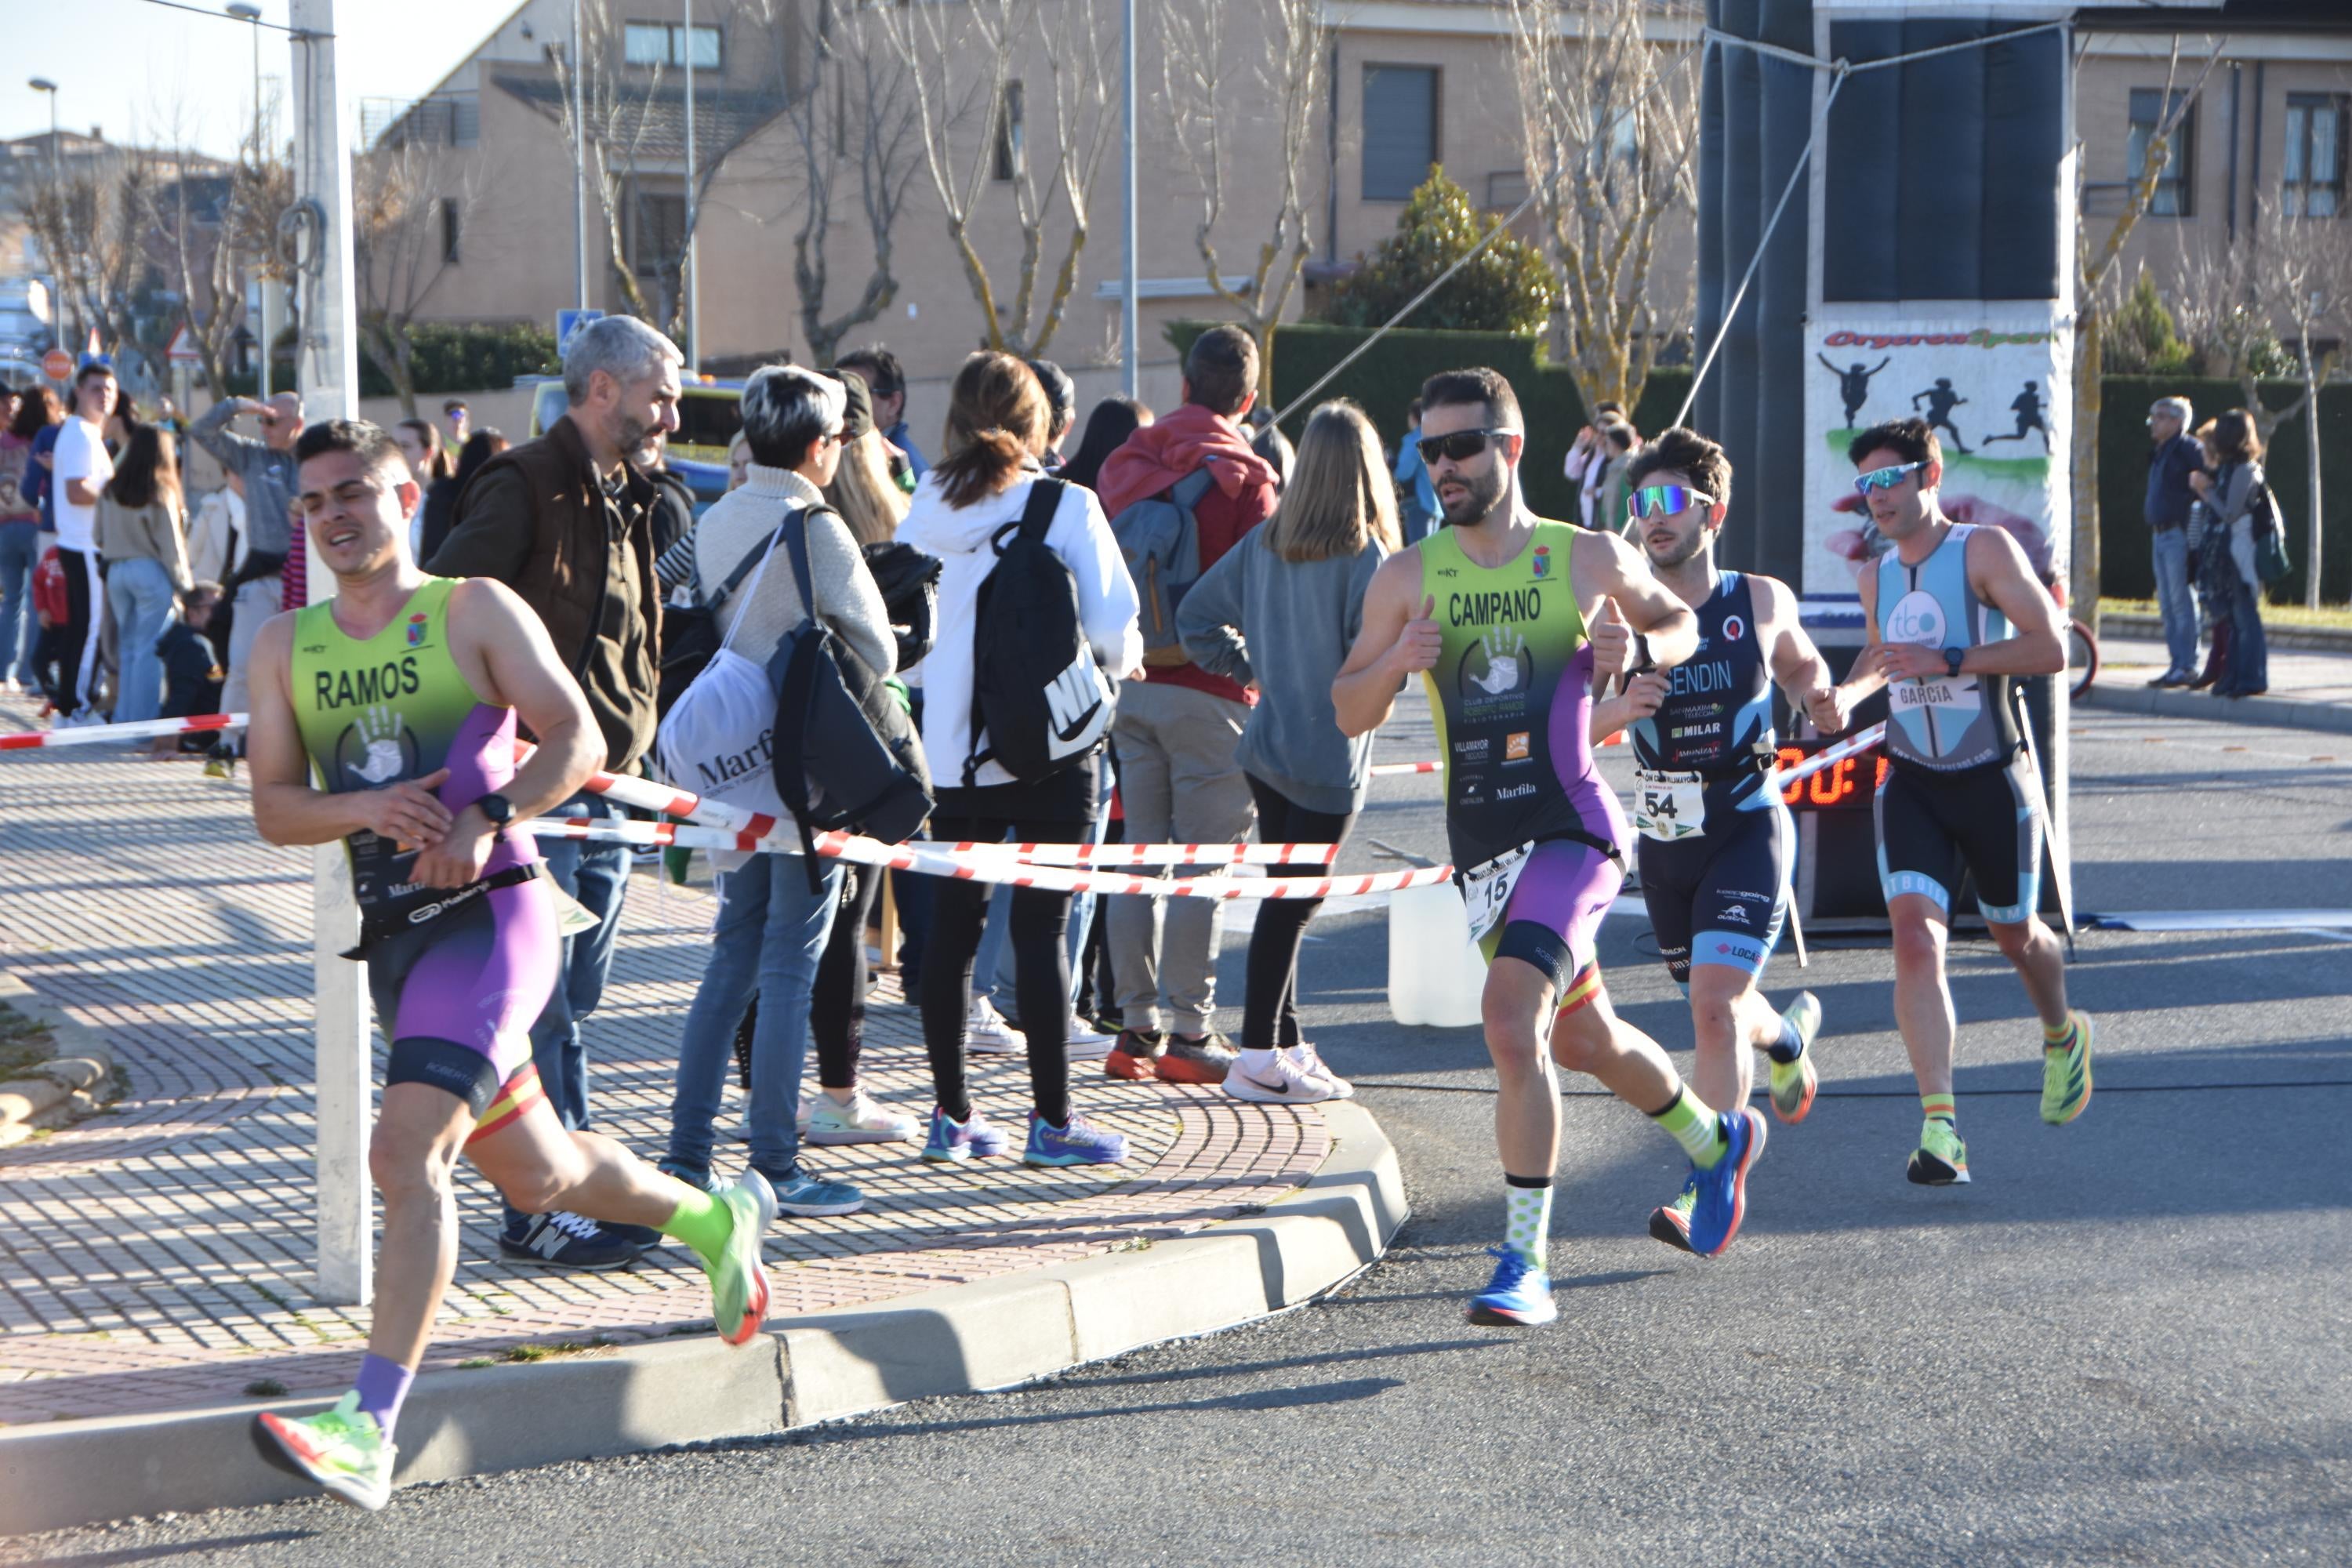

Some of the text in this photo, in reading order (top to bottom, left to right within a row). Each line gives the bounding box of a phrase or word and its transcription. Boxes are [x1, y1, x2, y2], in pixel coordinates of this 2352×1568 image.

[1450, 587, 1541, 626] CAMPANO
[316, 656, 420, 711] RAMOS
[1684, 722, 1720, 737] MILAR
[697, 728, 773, 789] Marf
[1454, 739, 1489, 753] VILLAMAYOR
[1497, 782, 1537, 800] Marfila
[1645, 792, 1678, 819] 54
[1484, 872, 1509, 909] 15
[1716, 888, 1770, 903] keepgoing
[1536, 946, 1562, 974] ROBERTO
